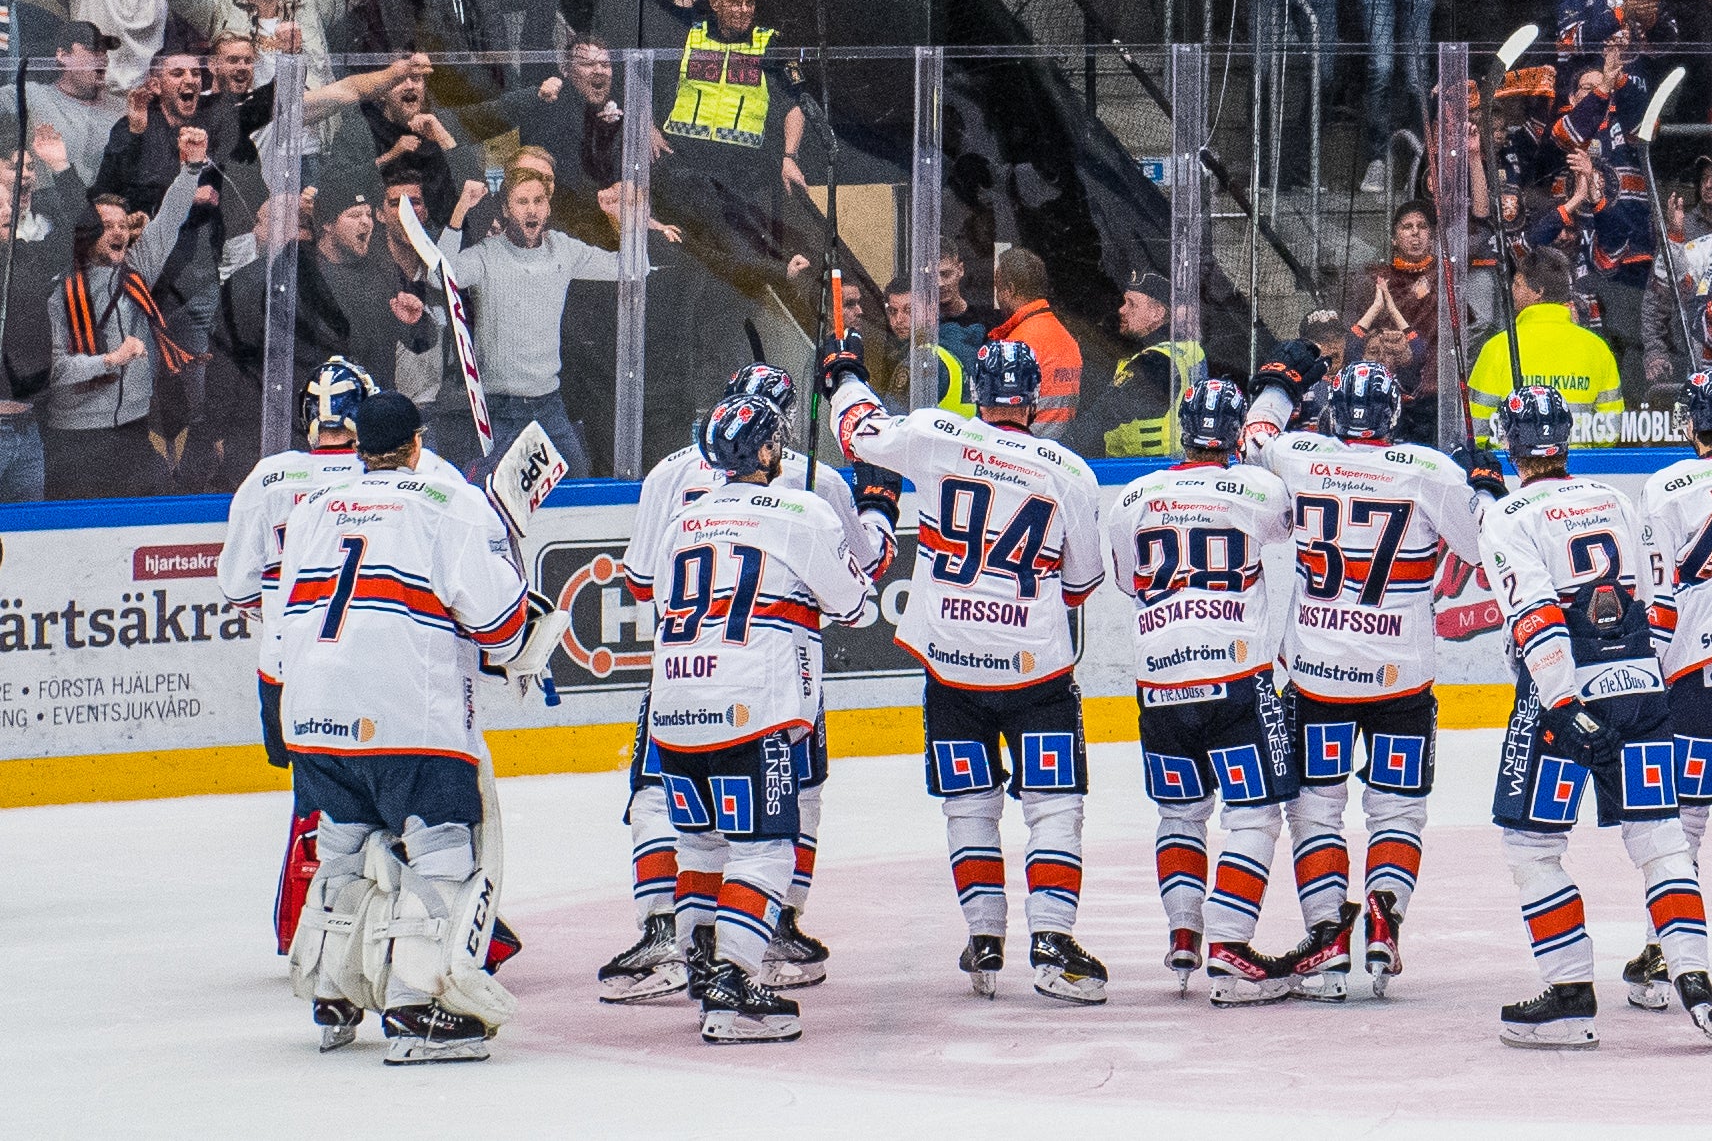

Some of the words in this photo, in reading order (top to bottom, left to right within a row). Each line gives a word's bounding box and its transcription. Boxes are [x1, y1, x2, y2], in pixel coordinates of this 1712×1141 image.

[1003, 372, 1017, 384] 94
[1521, 373, 1591, 392] UBLIKVÅRD
[1352, 407, 1365, 420] 37
[996, 438, 1027, 450] CCM
[962, 446, 985, 464] ICA
[986, 454, 1048, 481] Supermarket
[1309, 462, 1332, 478] ICA
[1333, 465, 1394, 483] Supermarket
[1558, 483, 1585, 493] CCM
[326, 500, 347, 514] ICA
[1148, 501, 1169, 513] ICA
[1170, 500, 1231, 513] Supermarket
[1545, 507, 1567, 521] ICA
[682, 518, 703, 533] ICA
[930, 474, 1060, 601] 94
[1295, 491, 1416, 609] 37
[1135, 525, 1248, 609] 28
[316, 534, 368, 643] 1
[661, 541, 768, 647] 91
[1502, 572, 1524, 609] 2
[940, 597, 1030, 629] PERSSON
[1138, 598, 1246, 636] GUSTAFSSON
[665, 654, 719, 681] CALOF
[926, 642, 1011, 671] Sundström
[1146, 644, 1227, 673] Sundström
[1292, 654, 1375, 684] Sundström
[38, 674, 105, 700] FÖRSTA
[111, 671, 191, 696] HJÄLPEN
[52, 695, 202, 726] EVENTSJUKVÅRD
[652, 707, 724, 728] Sundström
[1253, 672, 1288, 778] WELLNESS
[1503, 698, 1528, 776] NORDIC
[1508, 682, 1541, 797] WELLNESS
